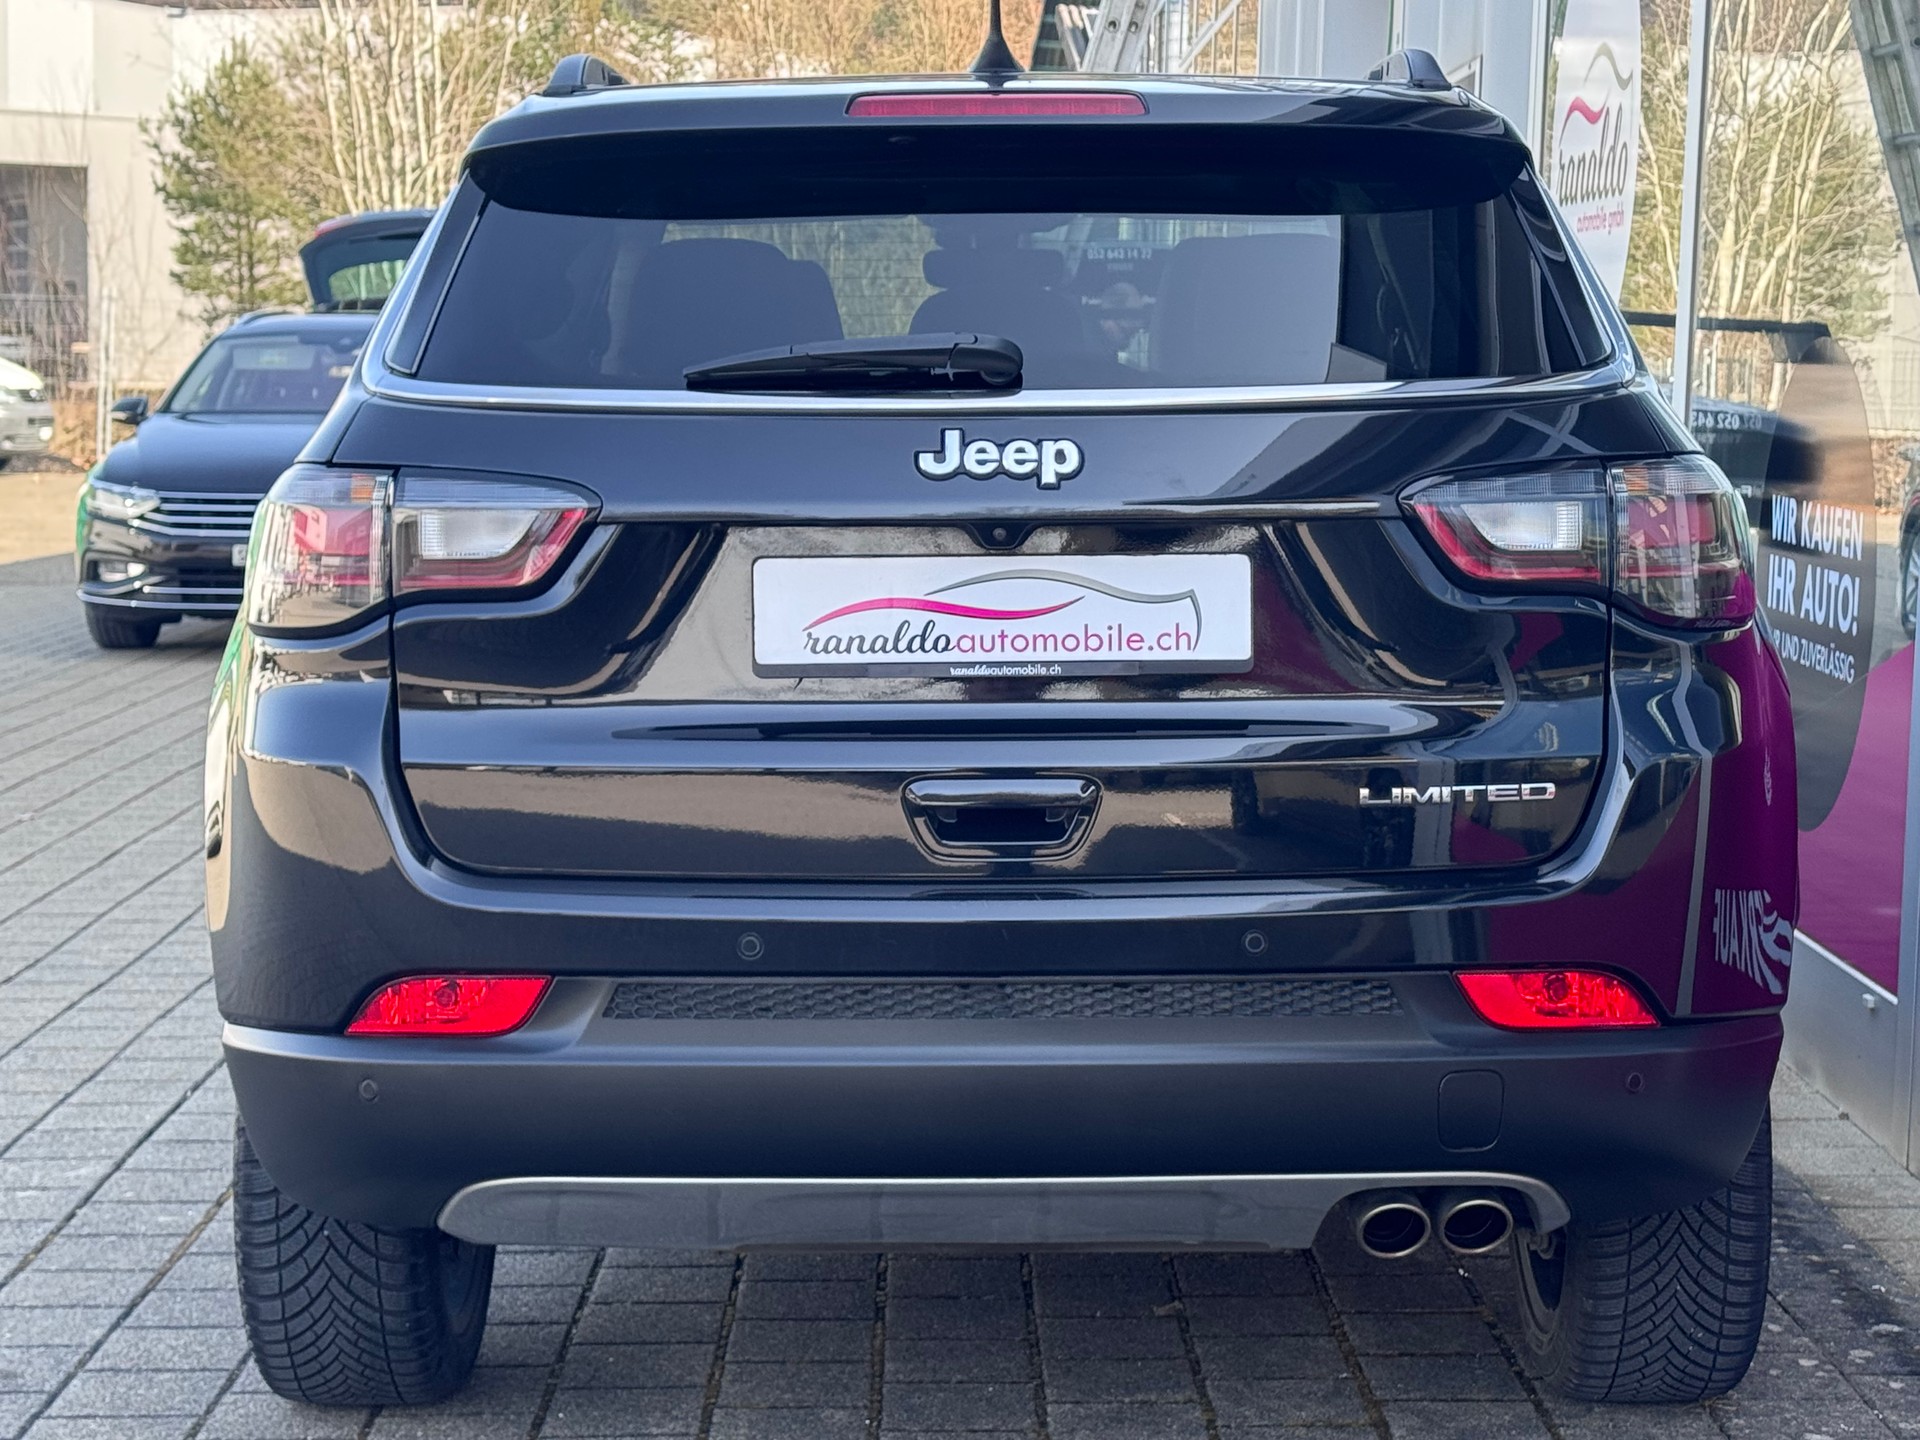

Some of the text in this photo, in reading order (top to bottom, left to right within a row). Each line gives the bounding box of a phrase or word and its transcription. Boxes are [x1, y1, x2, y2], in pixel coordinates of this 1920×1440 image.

[1556, 101, 1628, 208] ranaldo
[914, 428, 1084, 490] Jeep
[1772, 494, 1864, 561] WIR KAUFEN
[1767, 553, 1860, 637] IHR AUTO!
[1781, 631, 1800, 662] UND
[1800, 637, 1855, 684] ZUVERLÄSSIG
[1358, 782, 1556, 806] LIMITED
